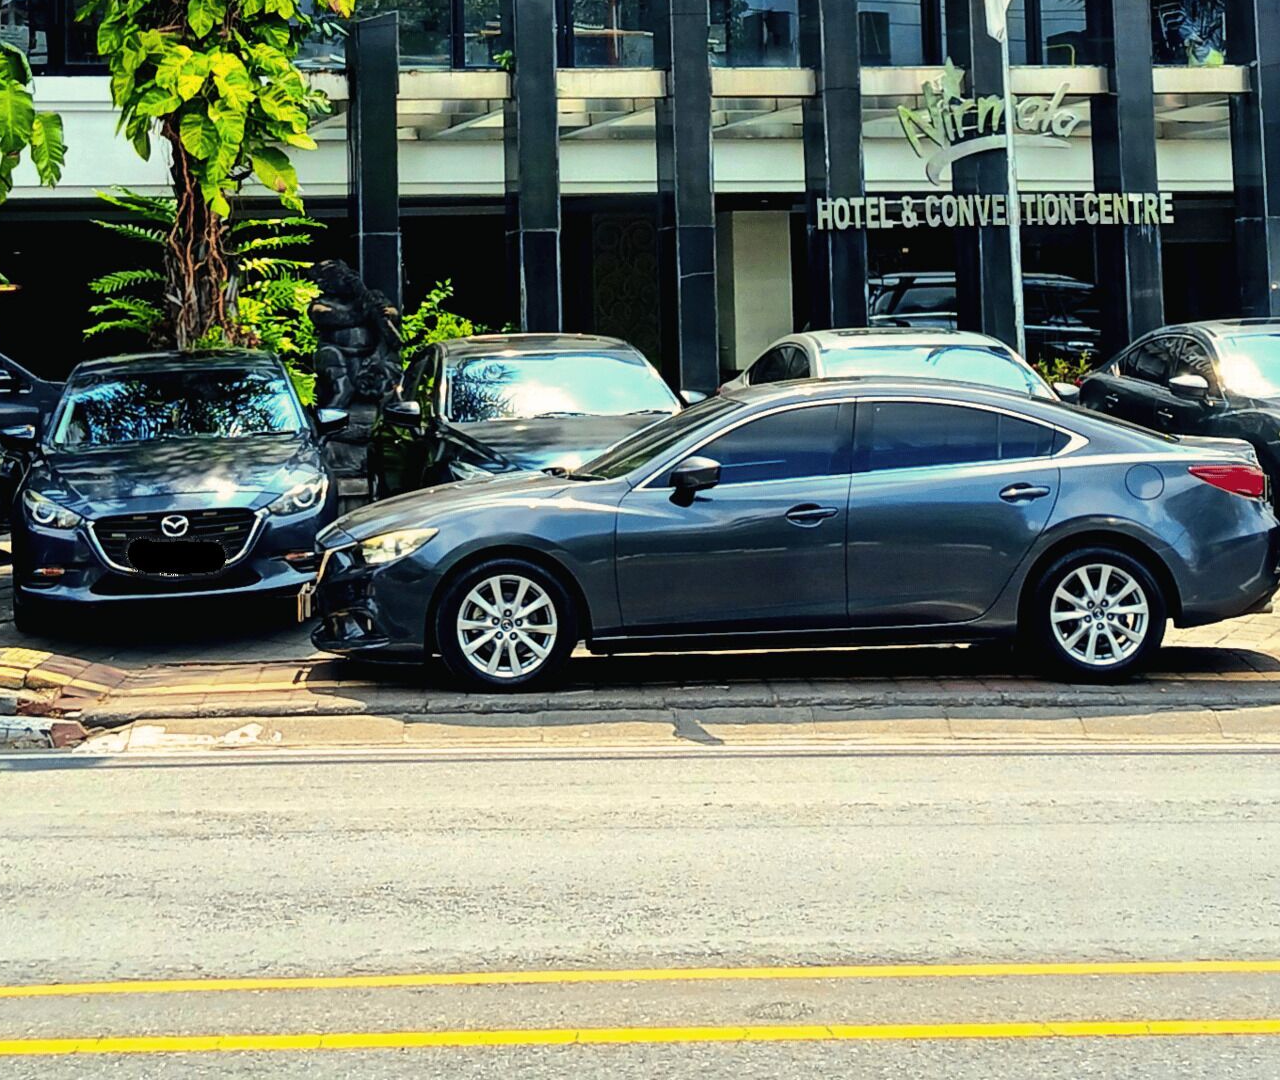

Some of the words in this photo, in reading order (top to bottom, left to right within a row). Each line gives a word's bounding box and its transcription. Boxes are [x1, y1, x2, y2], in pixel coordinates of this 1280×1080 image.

[897, 56, 1081, 159] Nirmala
[816, 197, 894, 231] HOTEL
[900, 195, 920, 228] &
[1083, 192, 1175, 225] CENTRE
